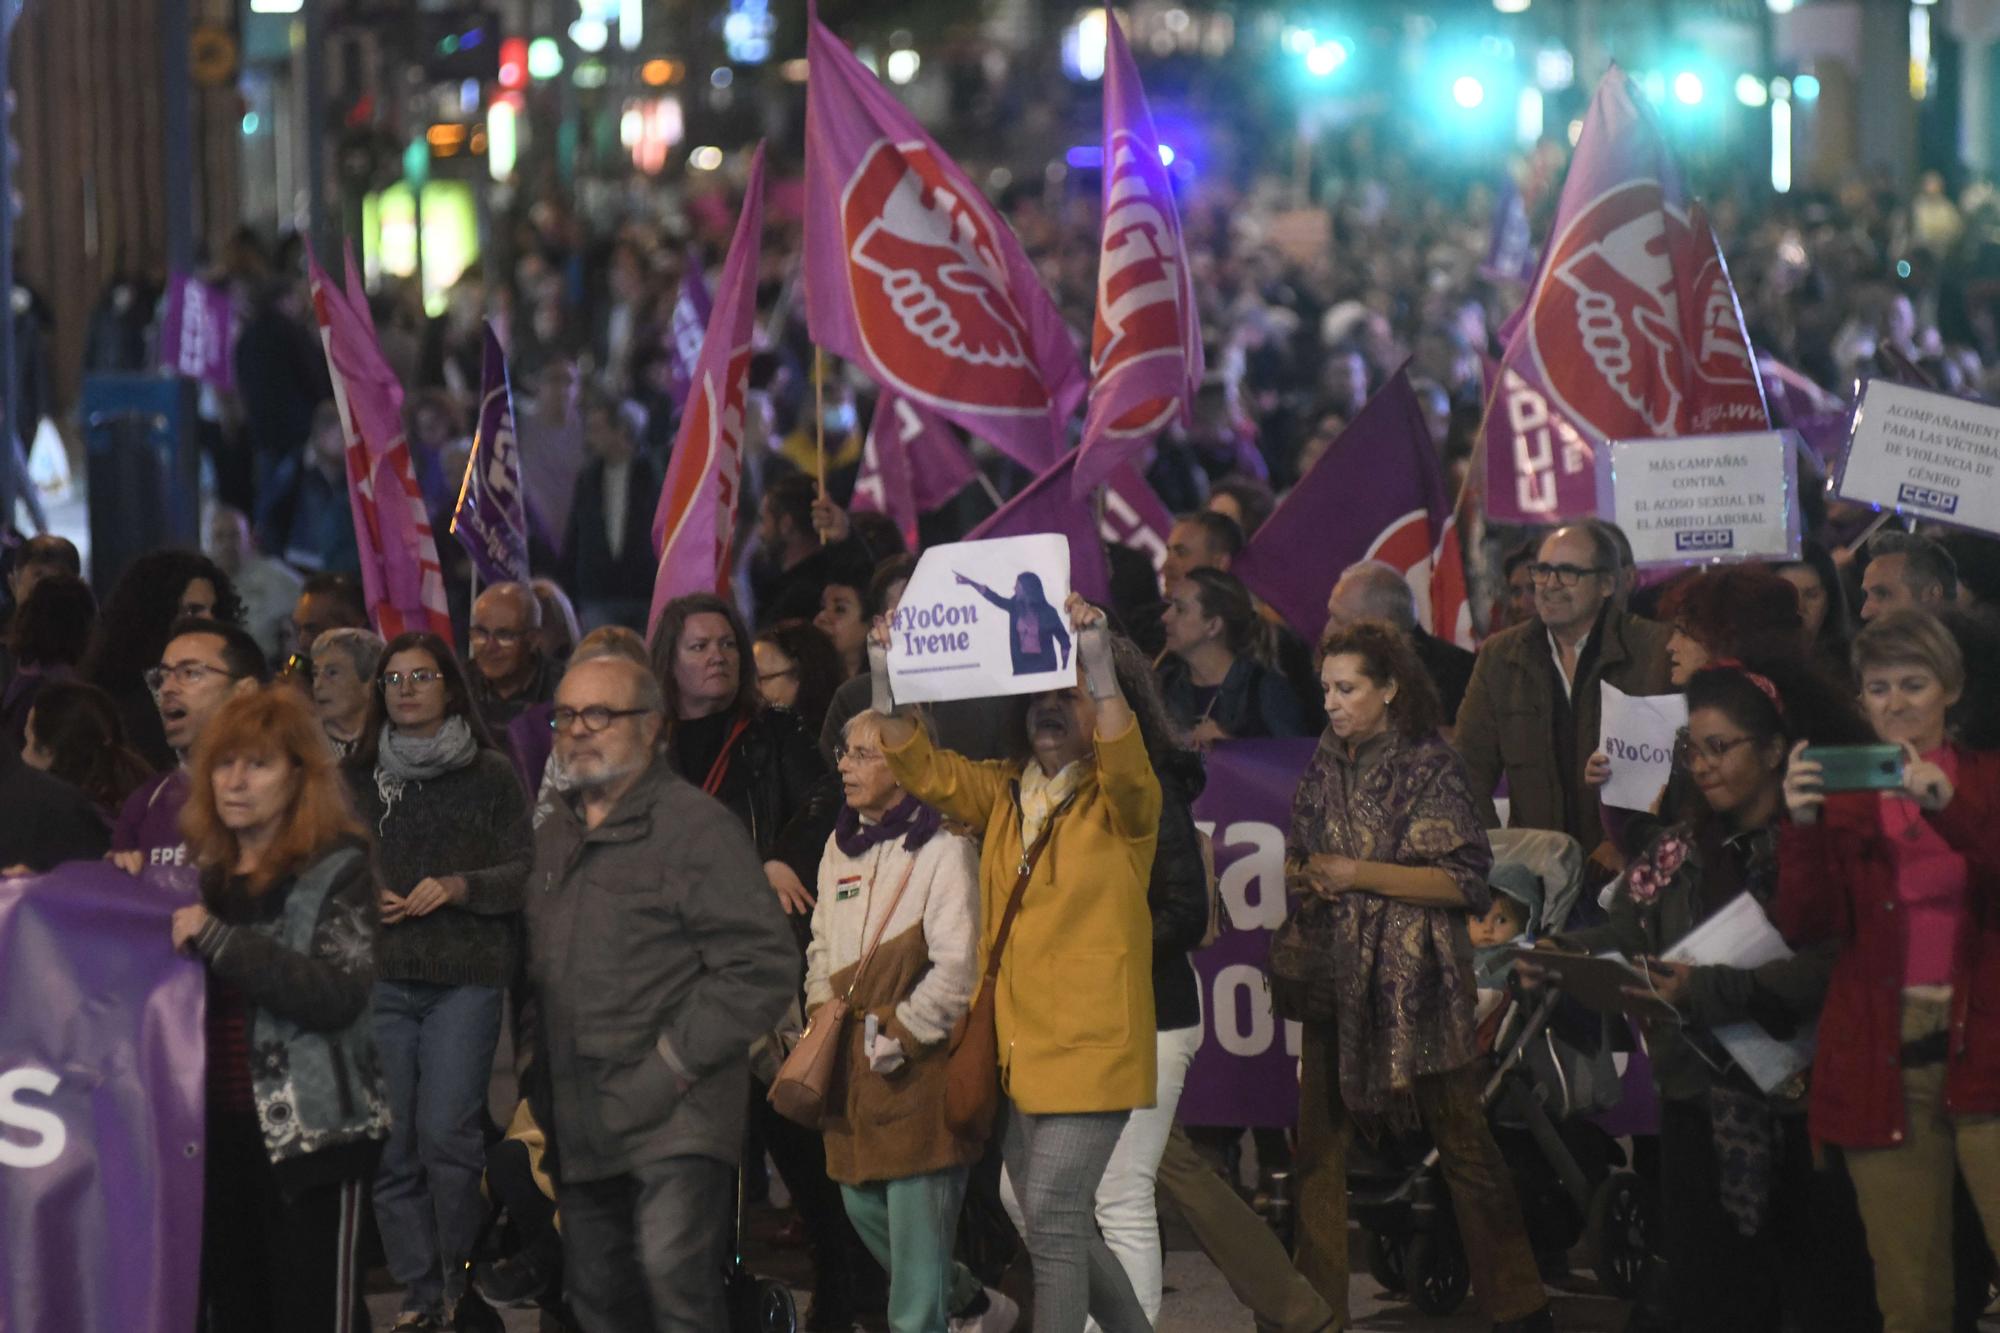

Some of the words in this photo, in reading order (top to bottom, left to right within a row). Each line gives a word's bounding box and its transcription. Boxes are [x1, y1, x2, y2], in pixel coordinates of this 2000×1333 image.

[1883, 421, 1915, 439] PARA
[1919, 429, 1942, 445] LAS
[1649, 456, 1676, 472] MÁS
[1678, 454, 1748, 469] CAMPAÑAS
[1885, 441, 1902, 455] DE
[1906, 446, 1972, 472] VIOLENCIA
[1976, 463, 1994, 478] DE
[1672, 476, 1725, 489] CONTRA
[1635, 501, 1648, 512] EL
[1653, 498, 1694, 511] ACOSO
[1699, 495, 1744, 509] SEXUAL
[1748, 494, 1766, 505] EN
[1902, 484, 1955, 507] CCOO
[1636, 519, 1651, 530] EL
[1708, 513, 1767, 526] LABORAL
[1679, 531, 1730, 546] CCOO
[892, 602, 978, 632] #YoCon
[903, 630, 970, 656] Irene
